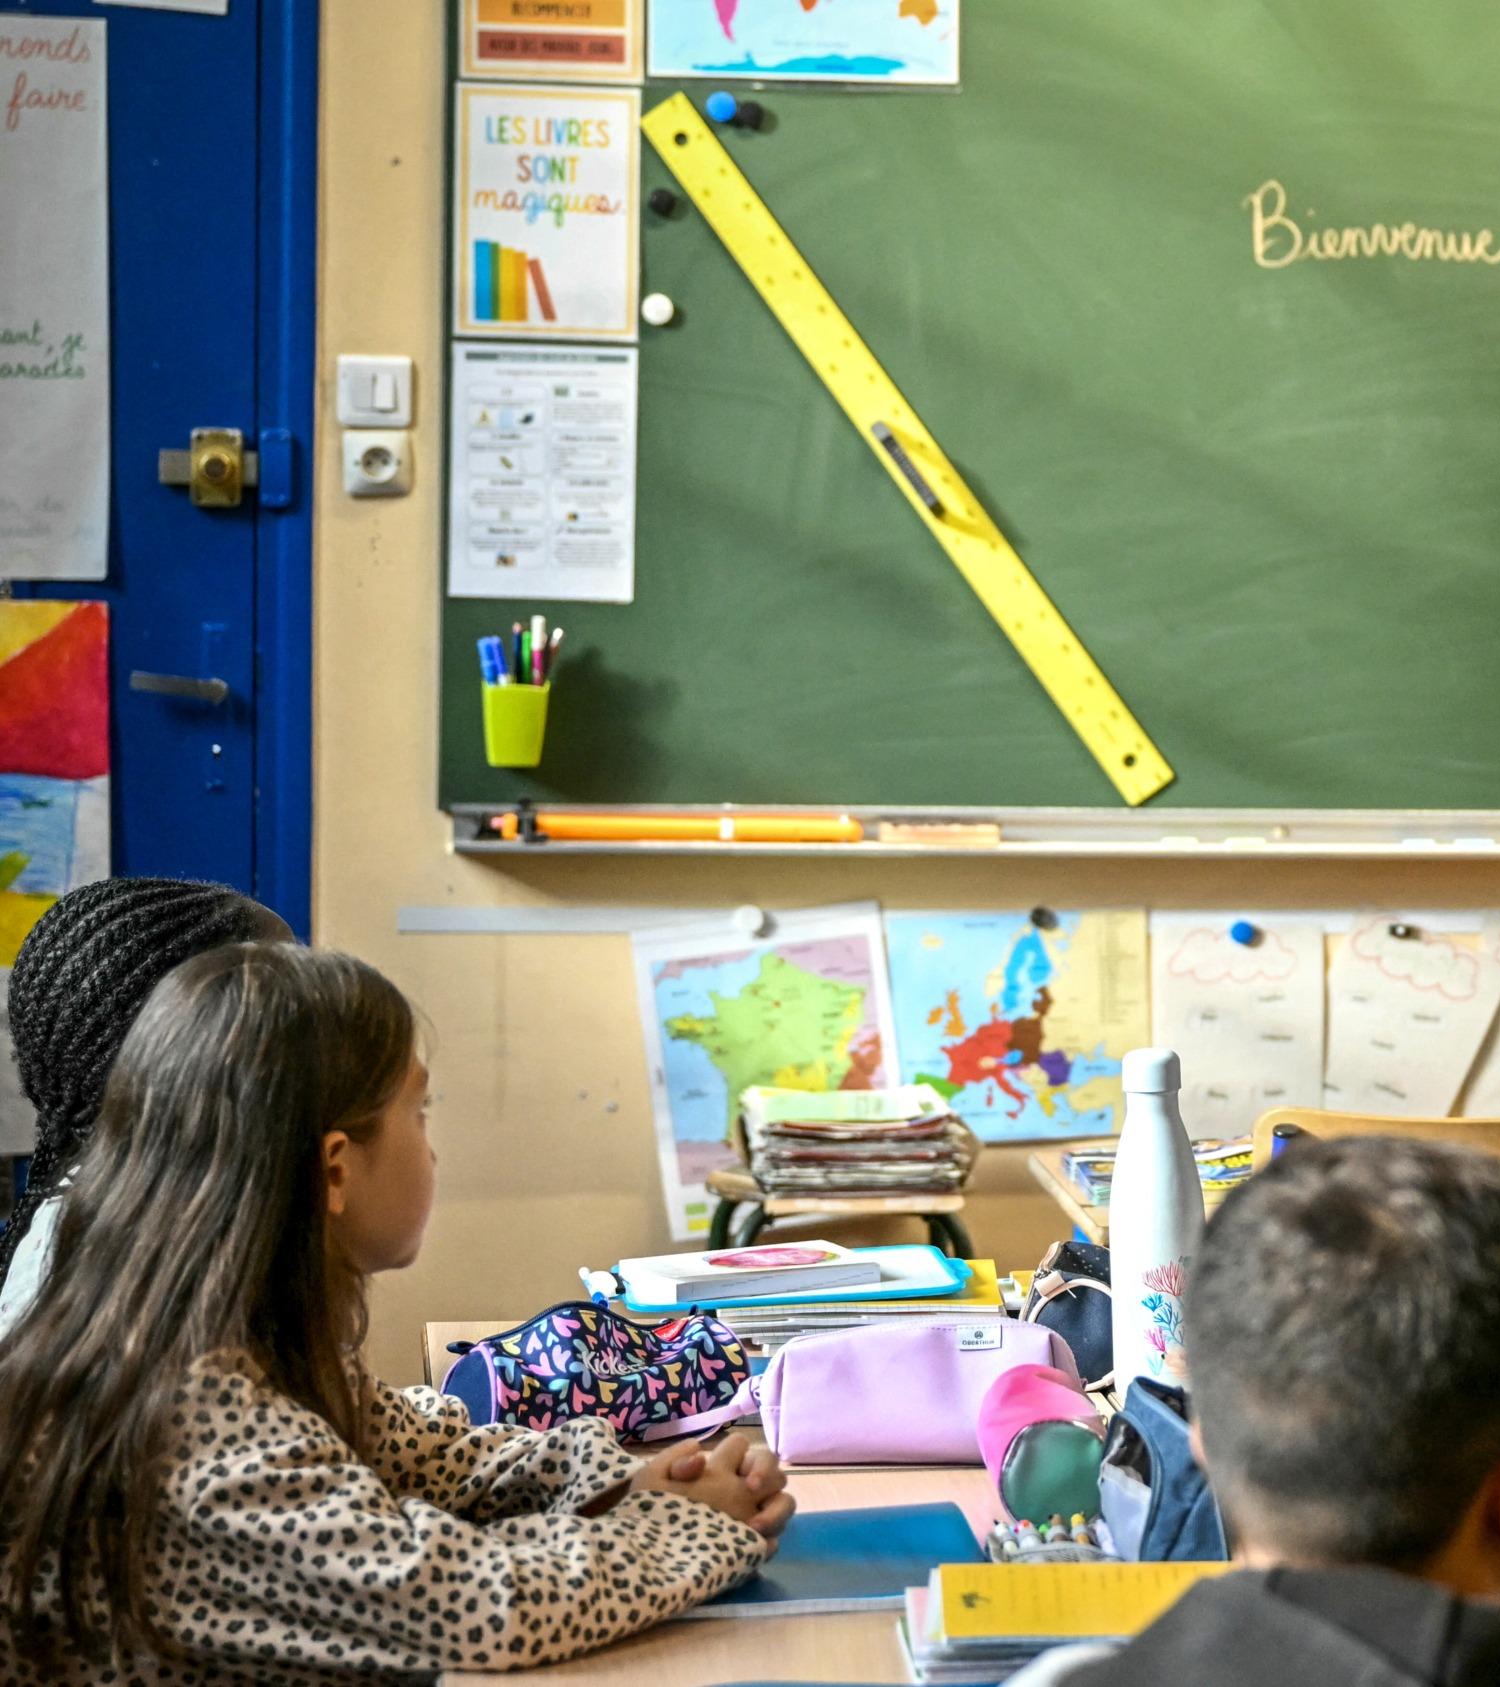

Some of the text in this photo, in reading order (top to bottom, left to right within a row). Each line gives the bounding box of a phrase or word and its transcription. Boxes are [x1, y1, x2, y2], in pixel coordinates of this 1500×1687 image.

[6, 70, 88, 131] faire
[485, 115, 611, 148] LES LIVRES
[516, 153, 580, 184] SONT
[473, 188, 622, 229] magiques
